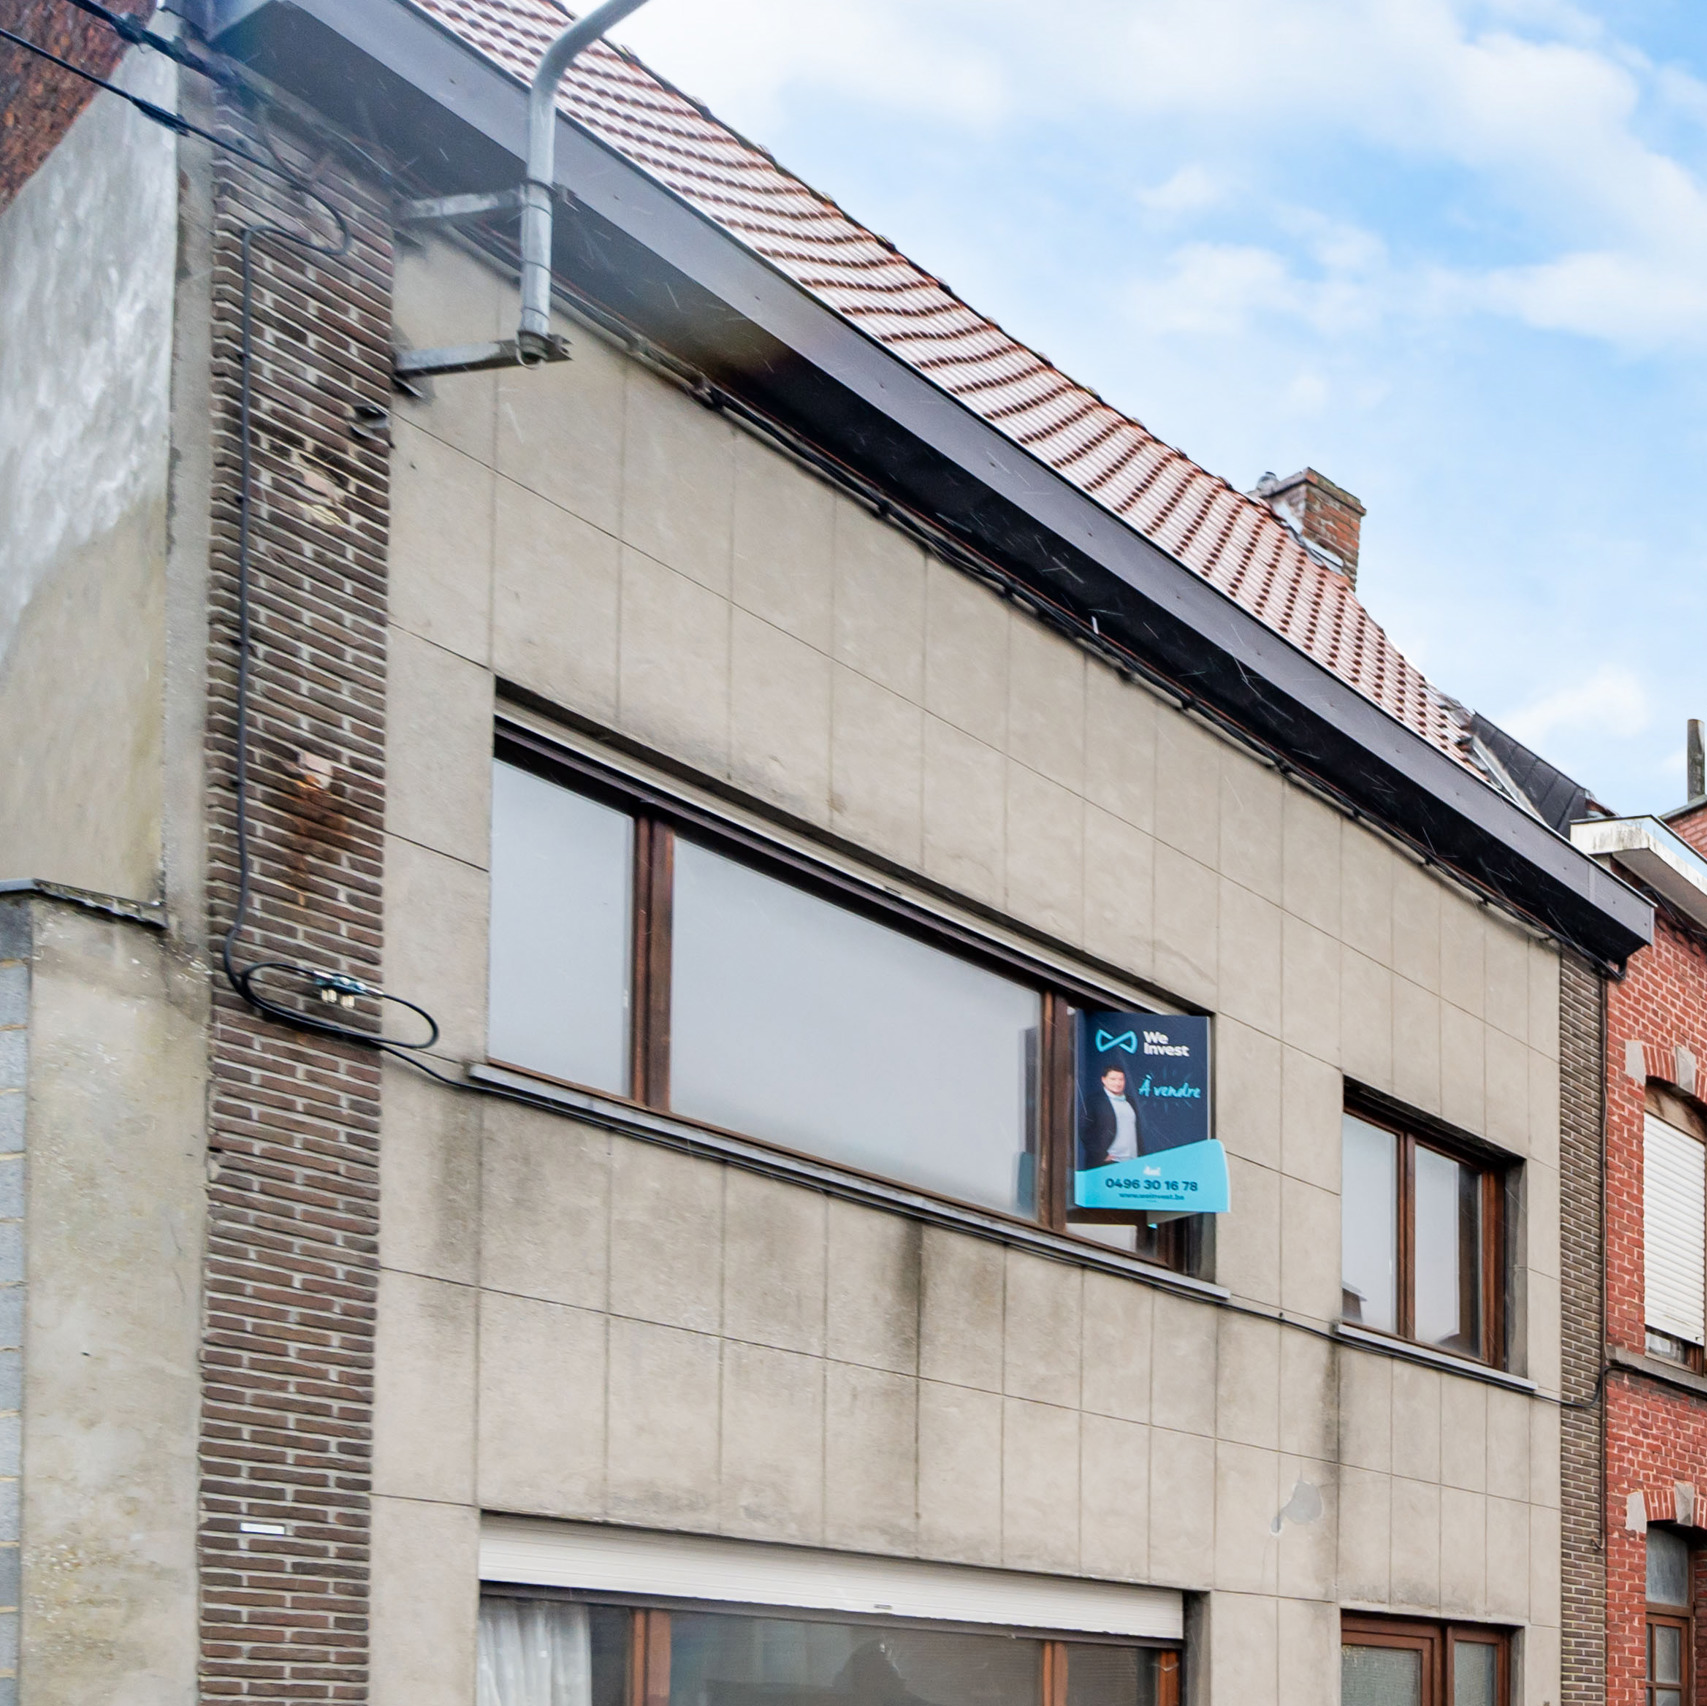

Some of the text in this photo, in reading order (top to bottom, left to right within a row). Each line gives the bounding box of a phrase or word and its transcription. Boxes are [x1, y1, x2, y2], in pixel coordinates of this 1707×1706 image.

[1143, 1031, 1168, 1044] We
[1143, 1042, 1190, 1057] Invest
[1138, 1074, 1201, 1098] À vendre
[1105, 1178, 1198, 1191] 0496 30 16 78
